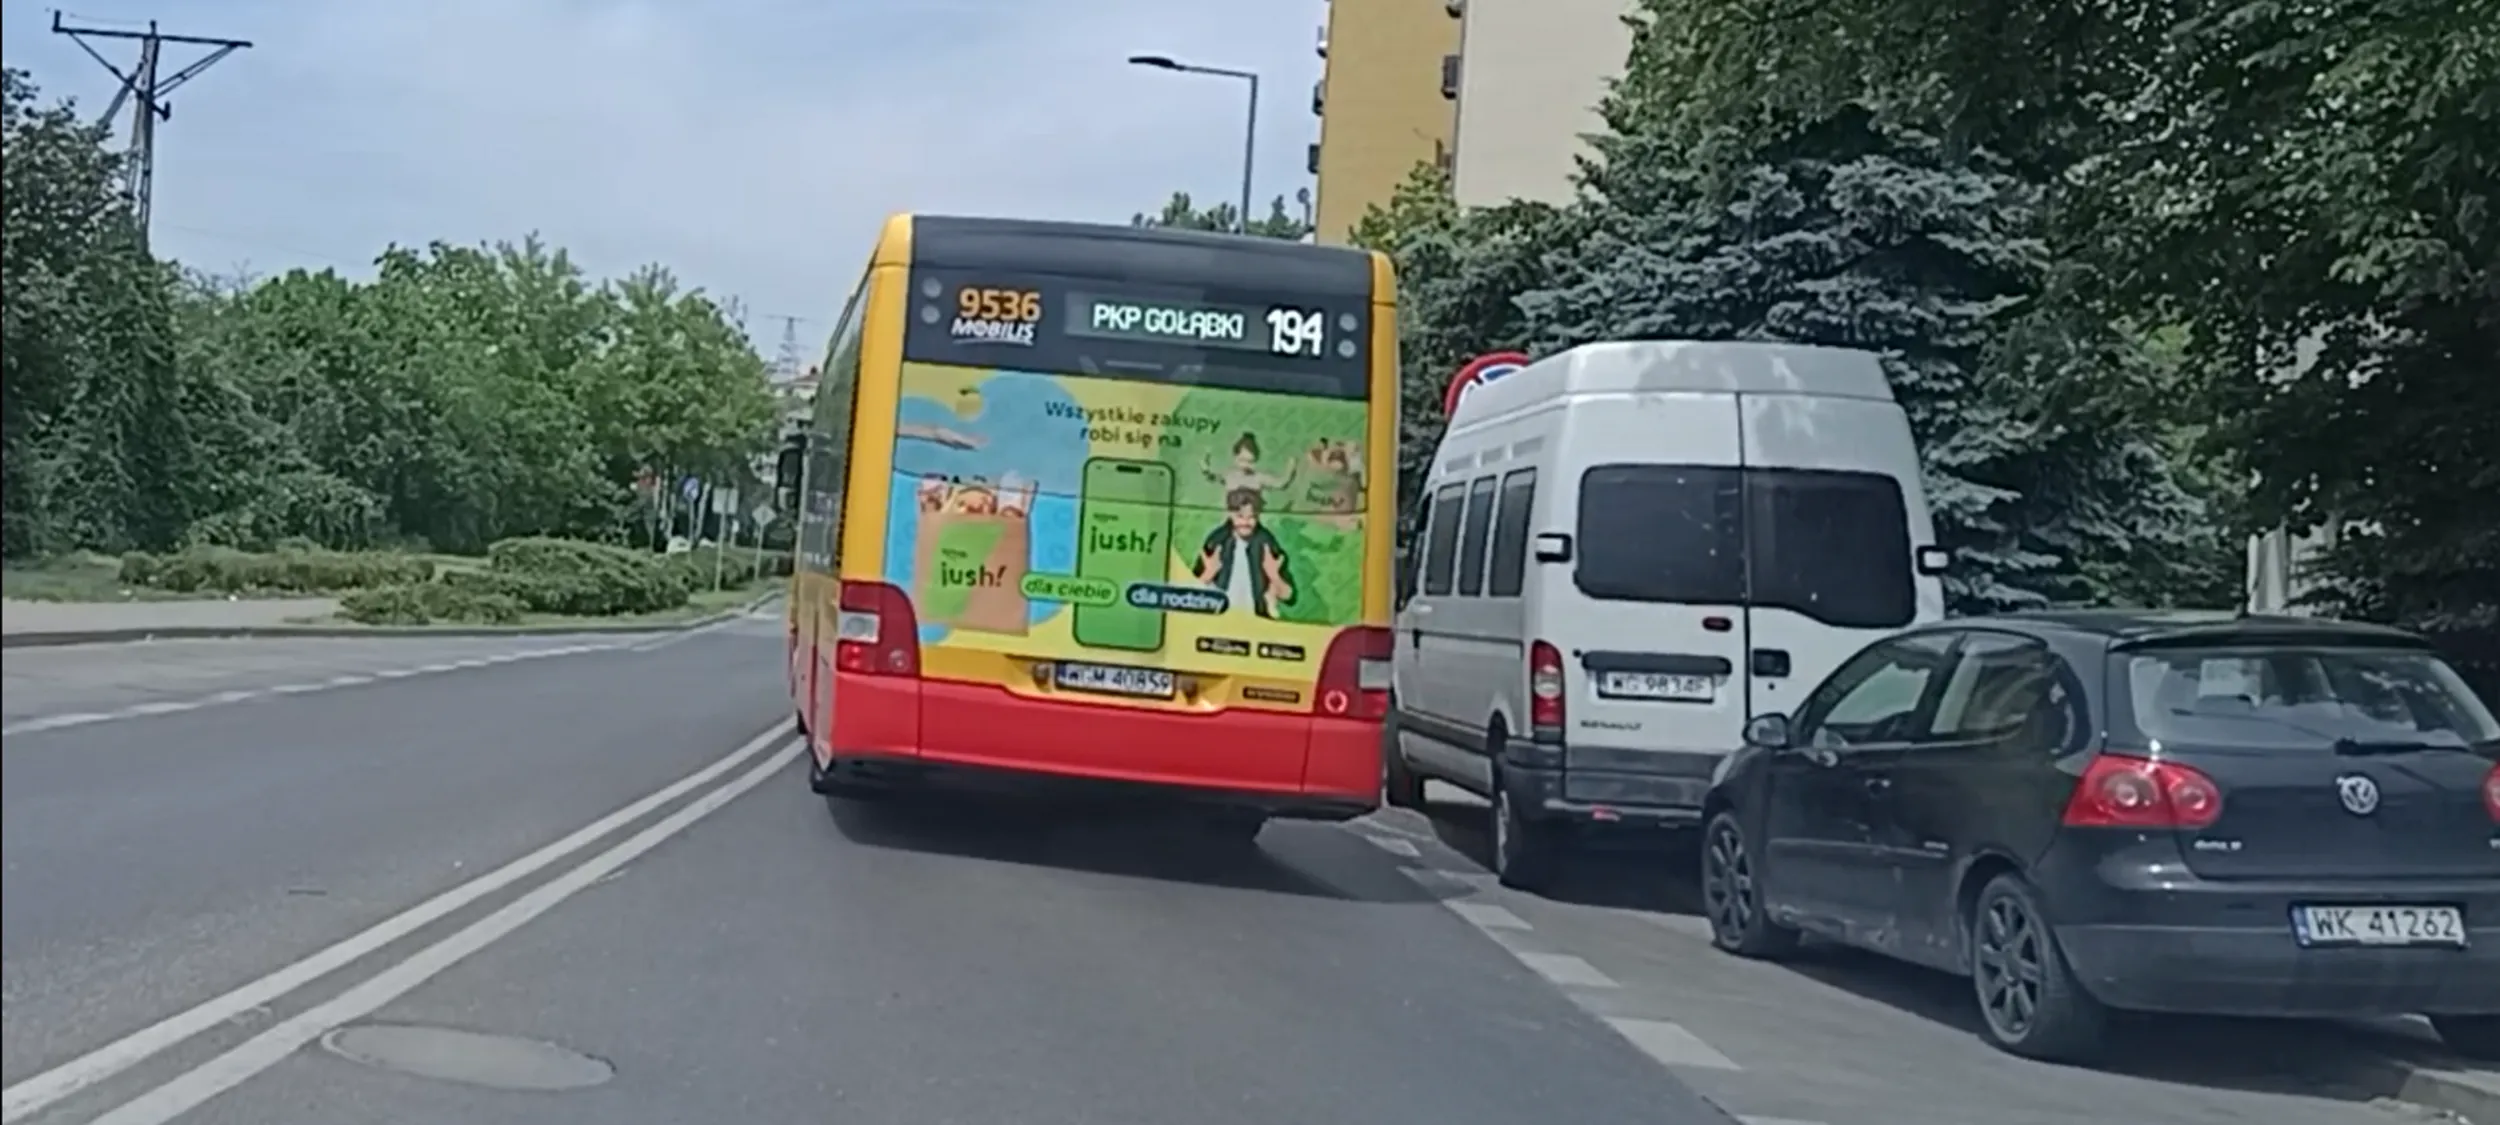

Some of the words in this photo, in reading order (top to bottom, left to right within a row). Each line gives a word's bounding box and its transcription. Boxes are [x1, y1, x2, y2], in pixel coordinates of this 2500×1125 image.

[959, 287, 1041, 321] 9536
[951, 317, 1036, 341] MOBILIS
[1093, 304, 1141, 330] PKP
[1145, 308, 1244, 339] GOŁĄBKI
[1267, 309, 1323, 356] 194
[1046, 401, 1144, 424] Wszystkie
[1150, 411, 1221, 434] zakupy
[1080, 427, 1120, 443] robi
[1125, 430, 1152, 449] się
[1158, 434, 1182, 448] na
[1091, 526, 1158, 554] jush!
[941, 562, 1007, 588] jush!
[1025, 579, 1052, 595] dla
[1058, 582, 1112, 600] ciebie
[1131, 588, 1157, 604] dla
[1162, 592, 1223, 614] rodziny
[2312, 910, 2356, 936] WK
[2369, 910, 2458, 937] 41262
